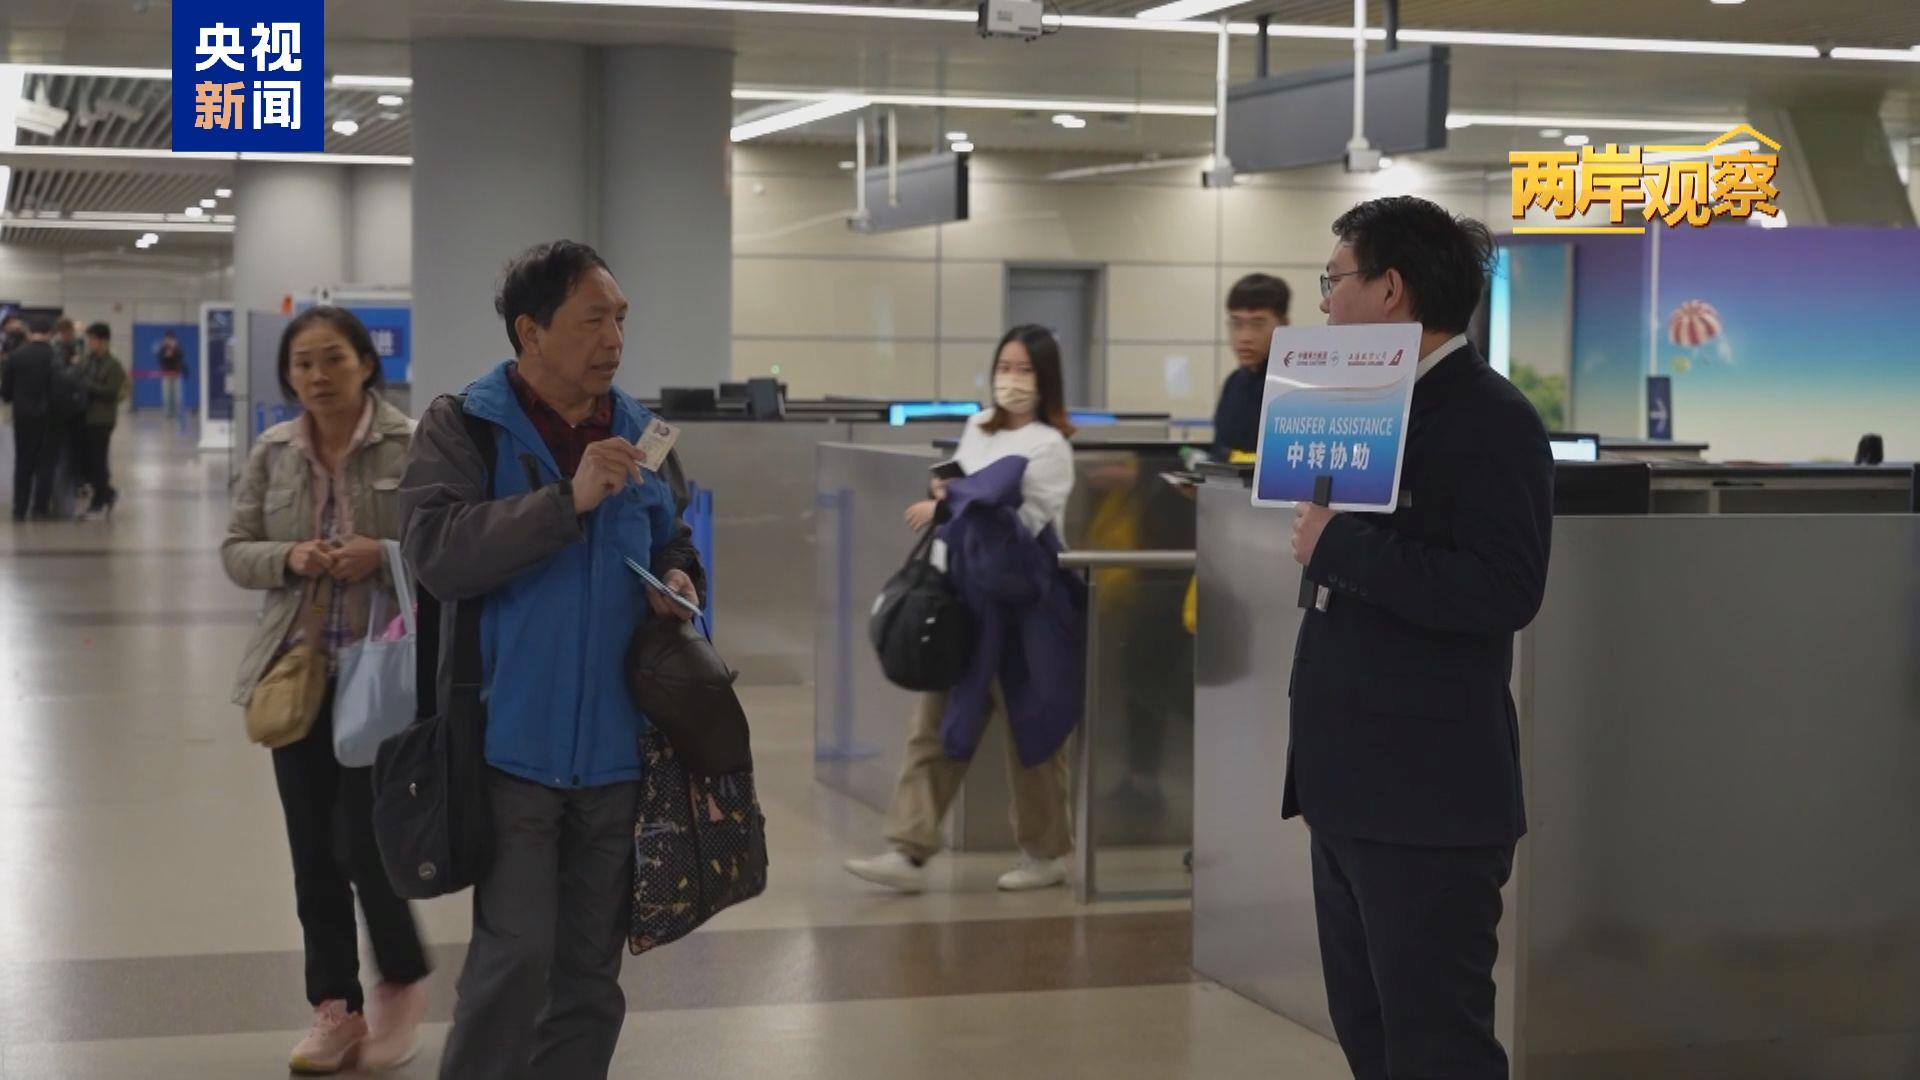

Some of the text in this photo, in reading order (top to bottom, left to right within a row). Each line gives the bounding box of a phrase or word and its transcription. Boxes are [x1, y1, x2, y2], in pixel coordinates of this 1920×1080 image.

[1274, 416, 1393, 436] TRANSFER ASSISTANCE
[1287, 441, 1370, 470] 中转协助
